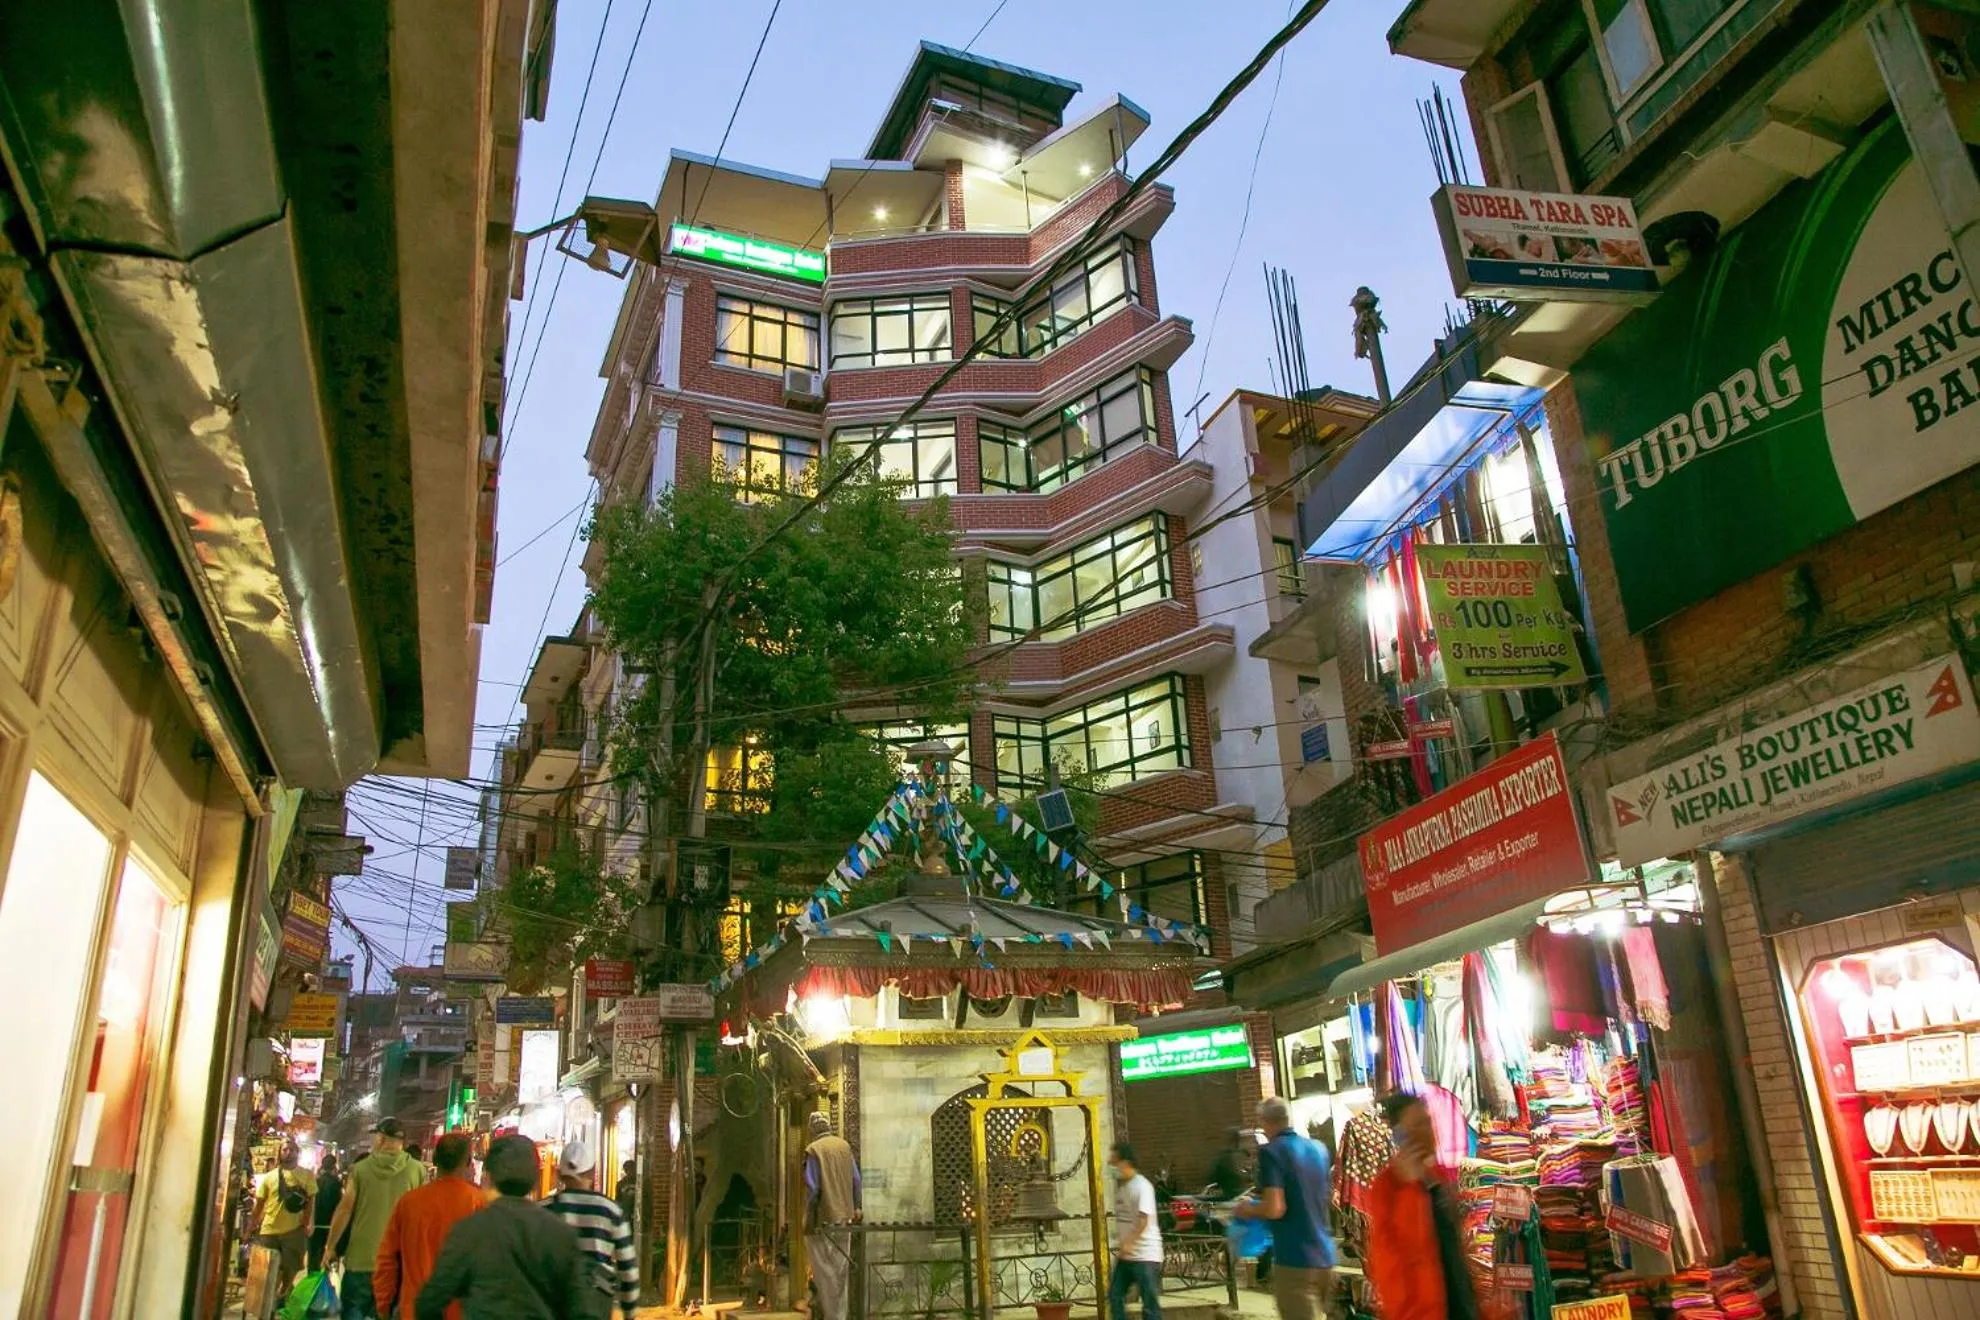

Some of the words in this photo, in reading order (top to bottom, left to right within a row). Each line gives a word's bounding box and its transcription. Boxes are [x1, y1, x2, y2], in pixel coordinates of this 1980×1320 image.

[1454, 192, 1529, 221] SUBHA
[1531, 198, 1589, 225] TARA
[1591, 203, 1632, 228] SPA
[1539, 267, 1560, 279] 2nd
[1562, 268, 1593, 280] Floor
[1600, 336, 1803, 511] TUBORG
[1425, 559, 1543, 579] LAUNDRY
[1447, 581, 1534, 597] SERVICE
[1437, 612, 1457, 628] Rs
[1455, 600, 1513, 628] 100
[1516, 612, 1538, 628] Per
[1452, 642, 1464, 659] 3
[1466, 642, 1497, 659] hrs
[1502, 641, 1568, 659] Service
[1664, 751, 1728, 799] ALI'S
[1739, 684, 1911, 773] BOUTIQUE
[1671, 777, 1754, 830] NEPALI
[1758, 717, 1915, 806] JEWELLERY
[1450, 785, 1503, 842] PASHMINA
[1499, 755, 1562, 818] EXPORTER
[1504, 831, 1540, 861] Exporter
[1557, 1301, 1626, 1320] LAUNDRY
